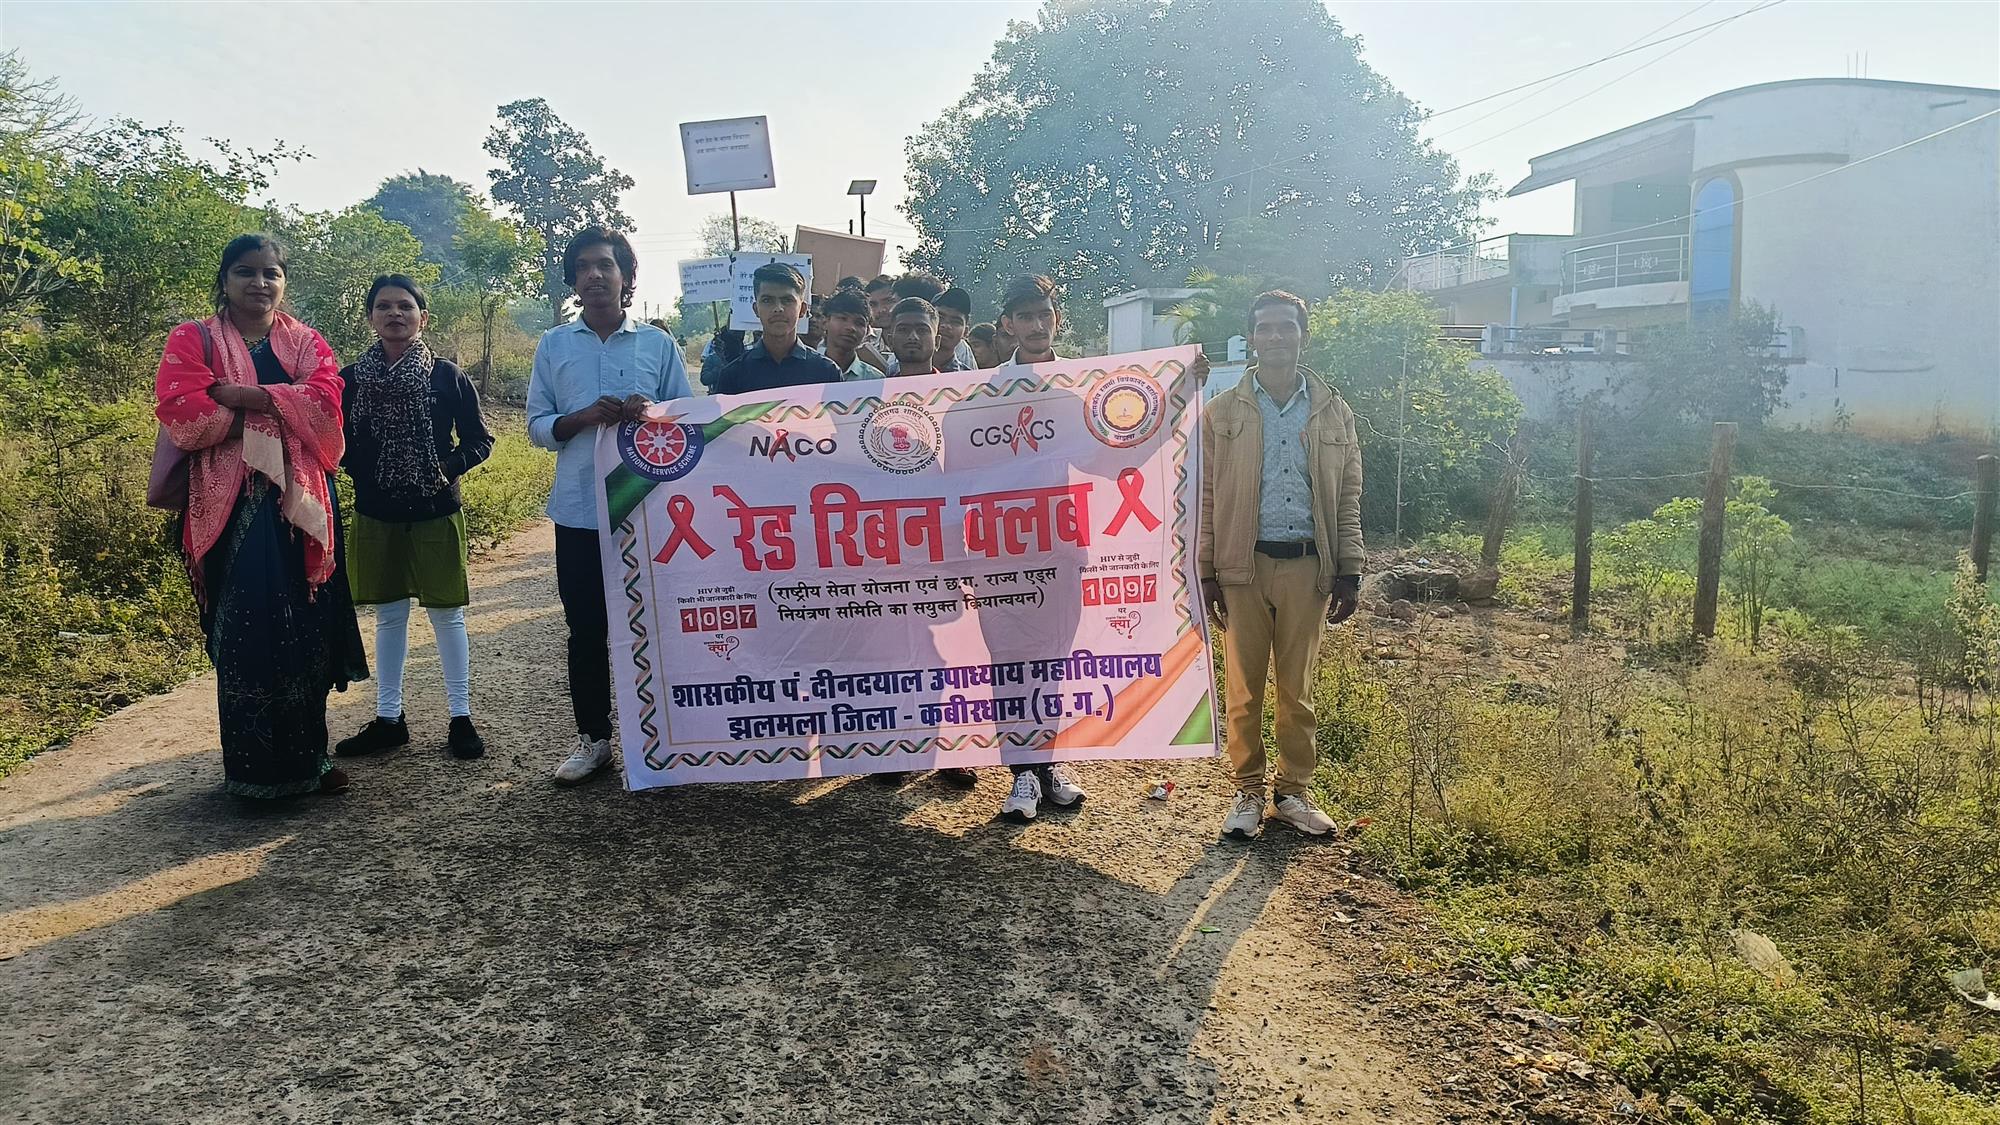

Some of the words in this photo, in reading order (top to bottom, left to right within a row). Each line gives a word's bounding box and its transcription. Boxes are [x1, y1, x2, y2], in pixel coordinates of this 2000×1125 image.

[903, 408, 924, 420] शासन
[749, 431, 838, 461] NACO
[970, 413, 1055, 453] CGSACS
[625, 446, 651, 473] NATIONAL
[651, 465, 679, 476] SERVICE
[677, 445, 697, 469] SCHEME
[712, 485, 797, 571] रेड
[810, 482, 946, 569] रिबन
[960, 482, 1094, 558] क्लब
[1079, 565, 1098, 574] किसी
[1099, 563, 1108, 572] भी
[1108, 562, 1140, 571] जानकारी
[1141, 561, 1149, 569] के
[1149, 560, 1160, 568] लिए
[1100, 555, 1117, 563] HIV
[826, 580, 857, 598] सेवा
[861, 577, 910, 596] योजना
[915, 575, 938, 594] एवं
[984, 571, 1018, 586] राज्य
[1023, 566, 1057, 584] एड्स
[1085, 578, 1156, 601] 1097
[677, 596, 695, 604] किसी
[705, 594, 735, 602] जानकारी
[736, 592, 743, 600] के
[743, 592, 757, 600] लिए
[777, 604, 831, 621] नियंत्रण
[836, 600, 882, 619] समिति
[889, 603, 907, 615] का
[682, 607, 755, 629] 1097
[672, 675, 775, 708] शासकीय
[928, 660, 1025, 692] उपाध्याय
[1030, 649, 1163, 683] महाविद्यालय
[727, 711, 828, 741] झलमला
[831, 703, 898, 734] जिला
[919, 694, 1026, 727] कबीरधाम
